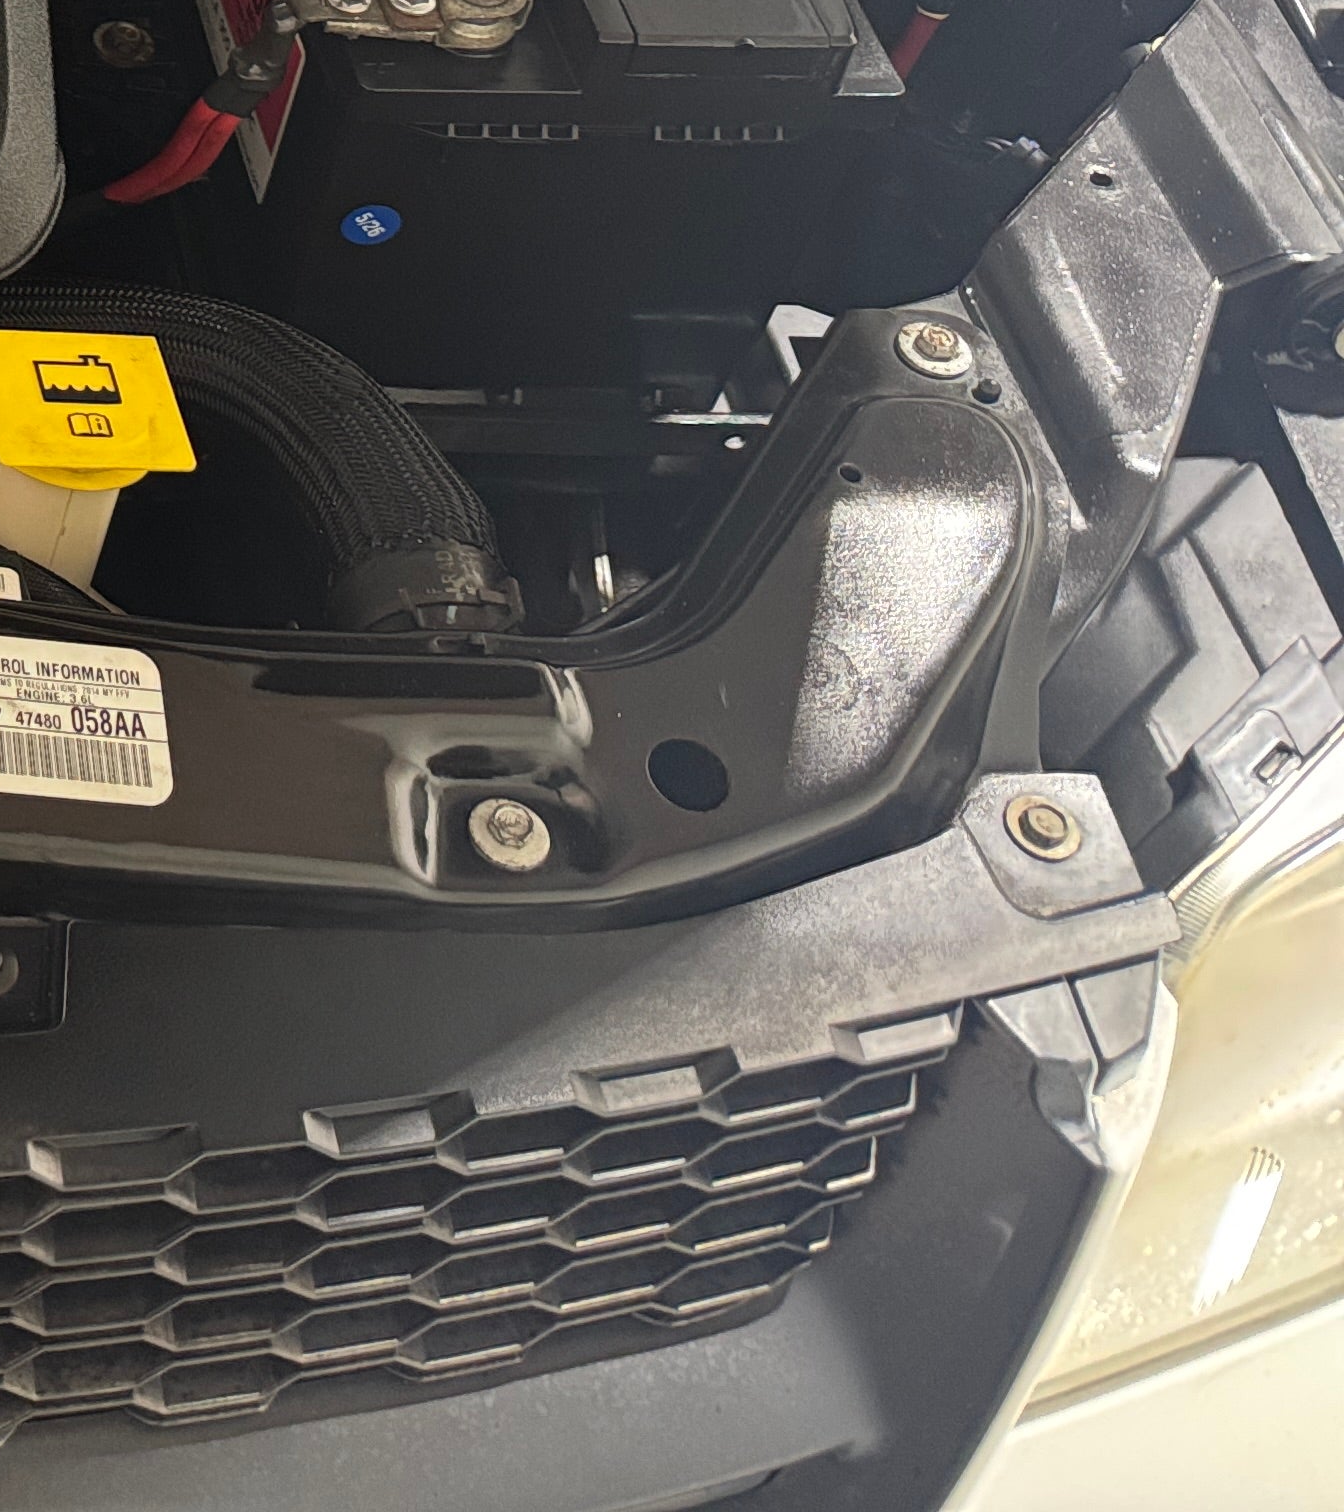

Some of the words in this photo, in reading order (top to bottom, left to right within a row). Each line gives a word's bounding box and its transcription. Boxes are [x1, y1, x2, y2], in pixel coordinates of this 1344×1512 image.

[355, 212, 386, 237] 5/26
[14, 678, 24, 687] TO
[36, 661, 141, 686] INFORMATION
[16, 688, 66, 703] ENGINE:
[69, 693, 94, 705] 3.6L
[16, 711, 62, 729] 47480
[71, 706, 147, 738] 058AA
